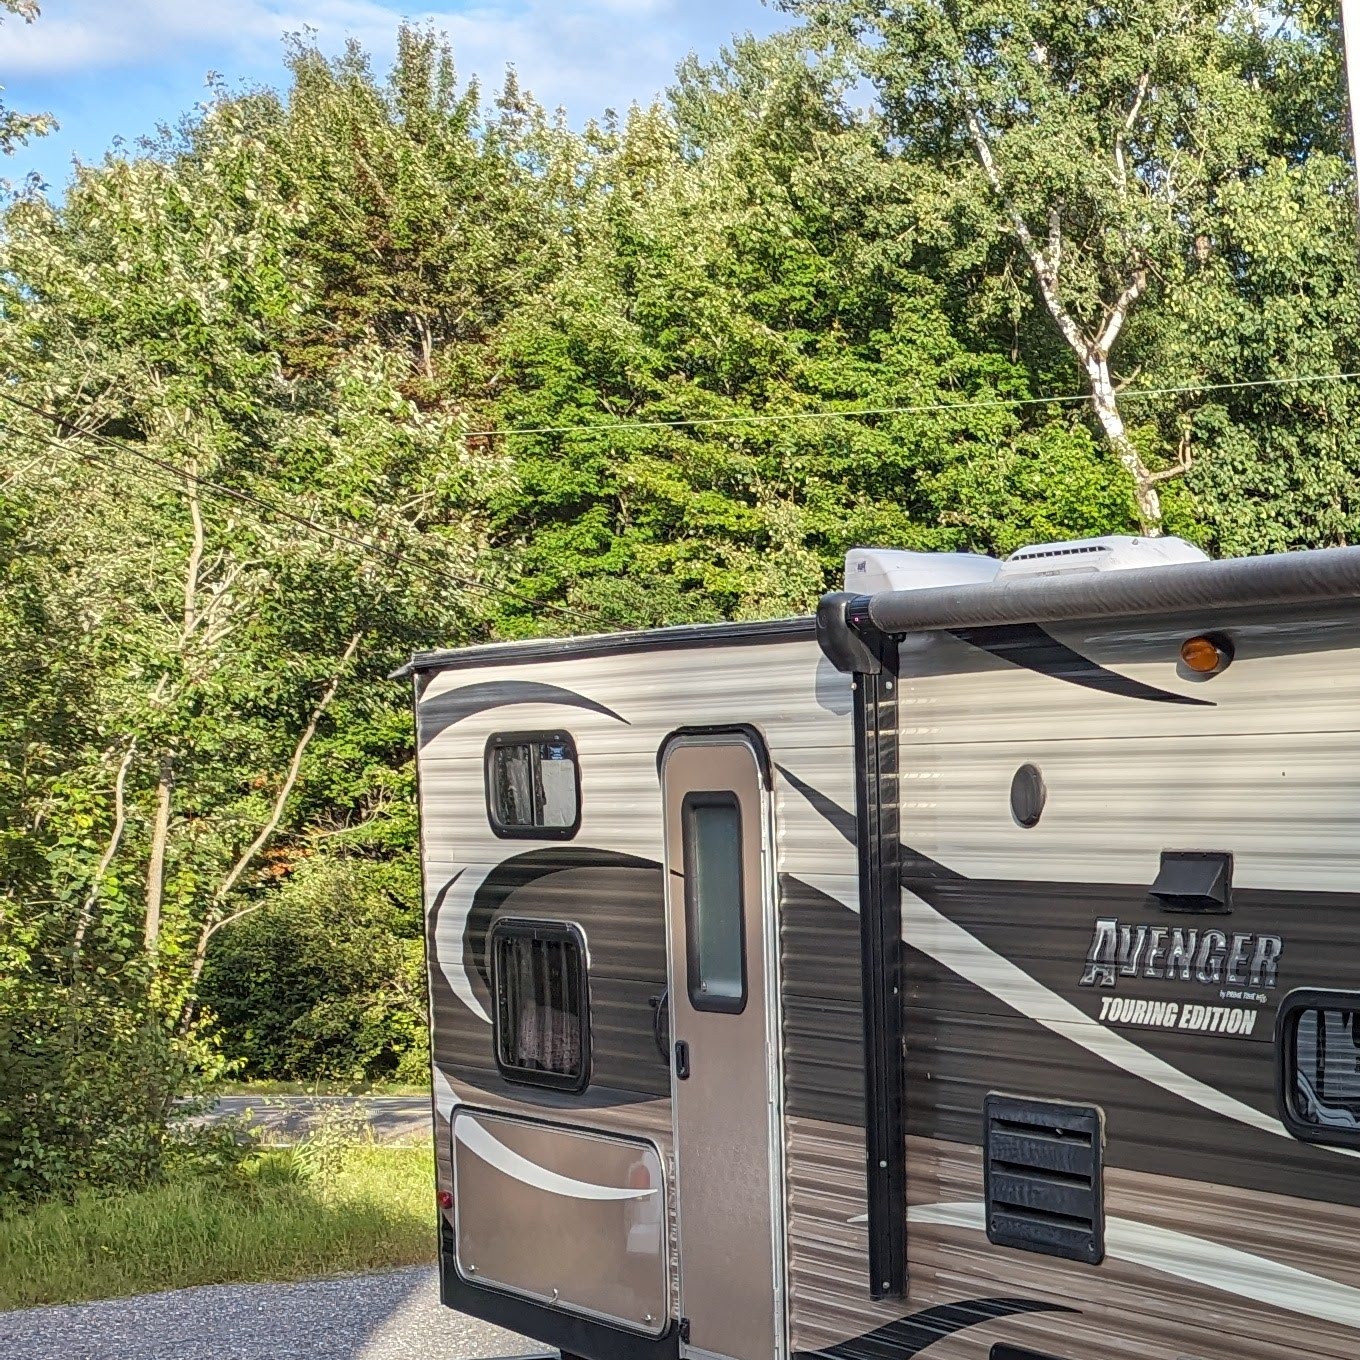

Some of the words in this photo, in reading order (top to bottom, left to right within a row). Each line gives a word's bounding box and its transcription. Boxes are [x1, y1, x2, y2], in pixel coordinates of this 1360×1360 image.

[1078, 917, 1284, 990] AVENGER
[1099, 996, 1179, 1028] TOURING
[1178, 1004, 1257, 1035] EDITION
